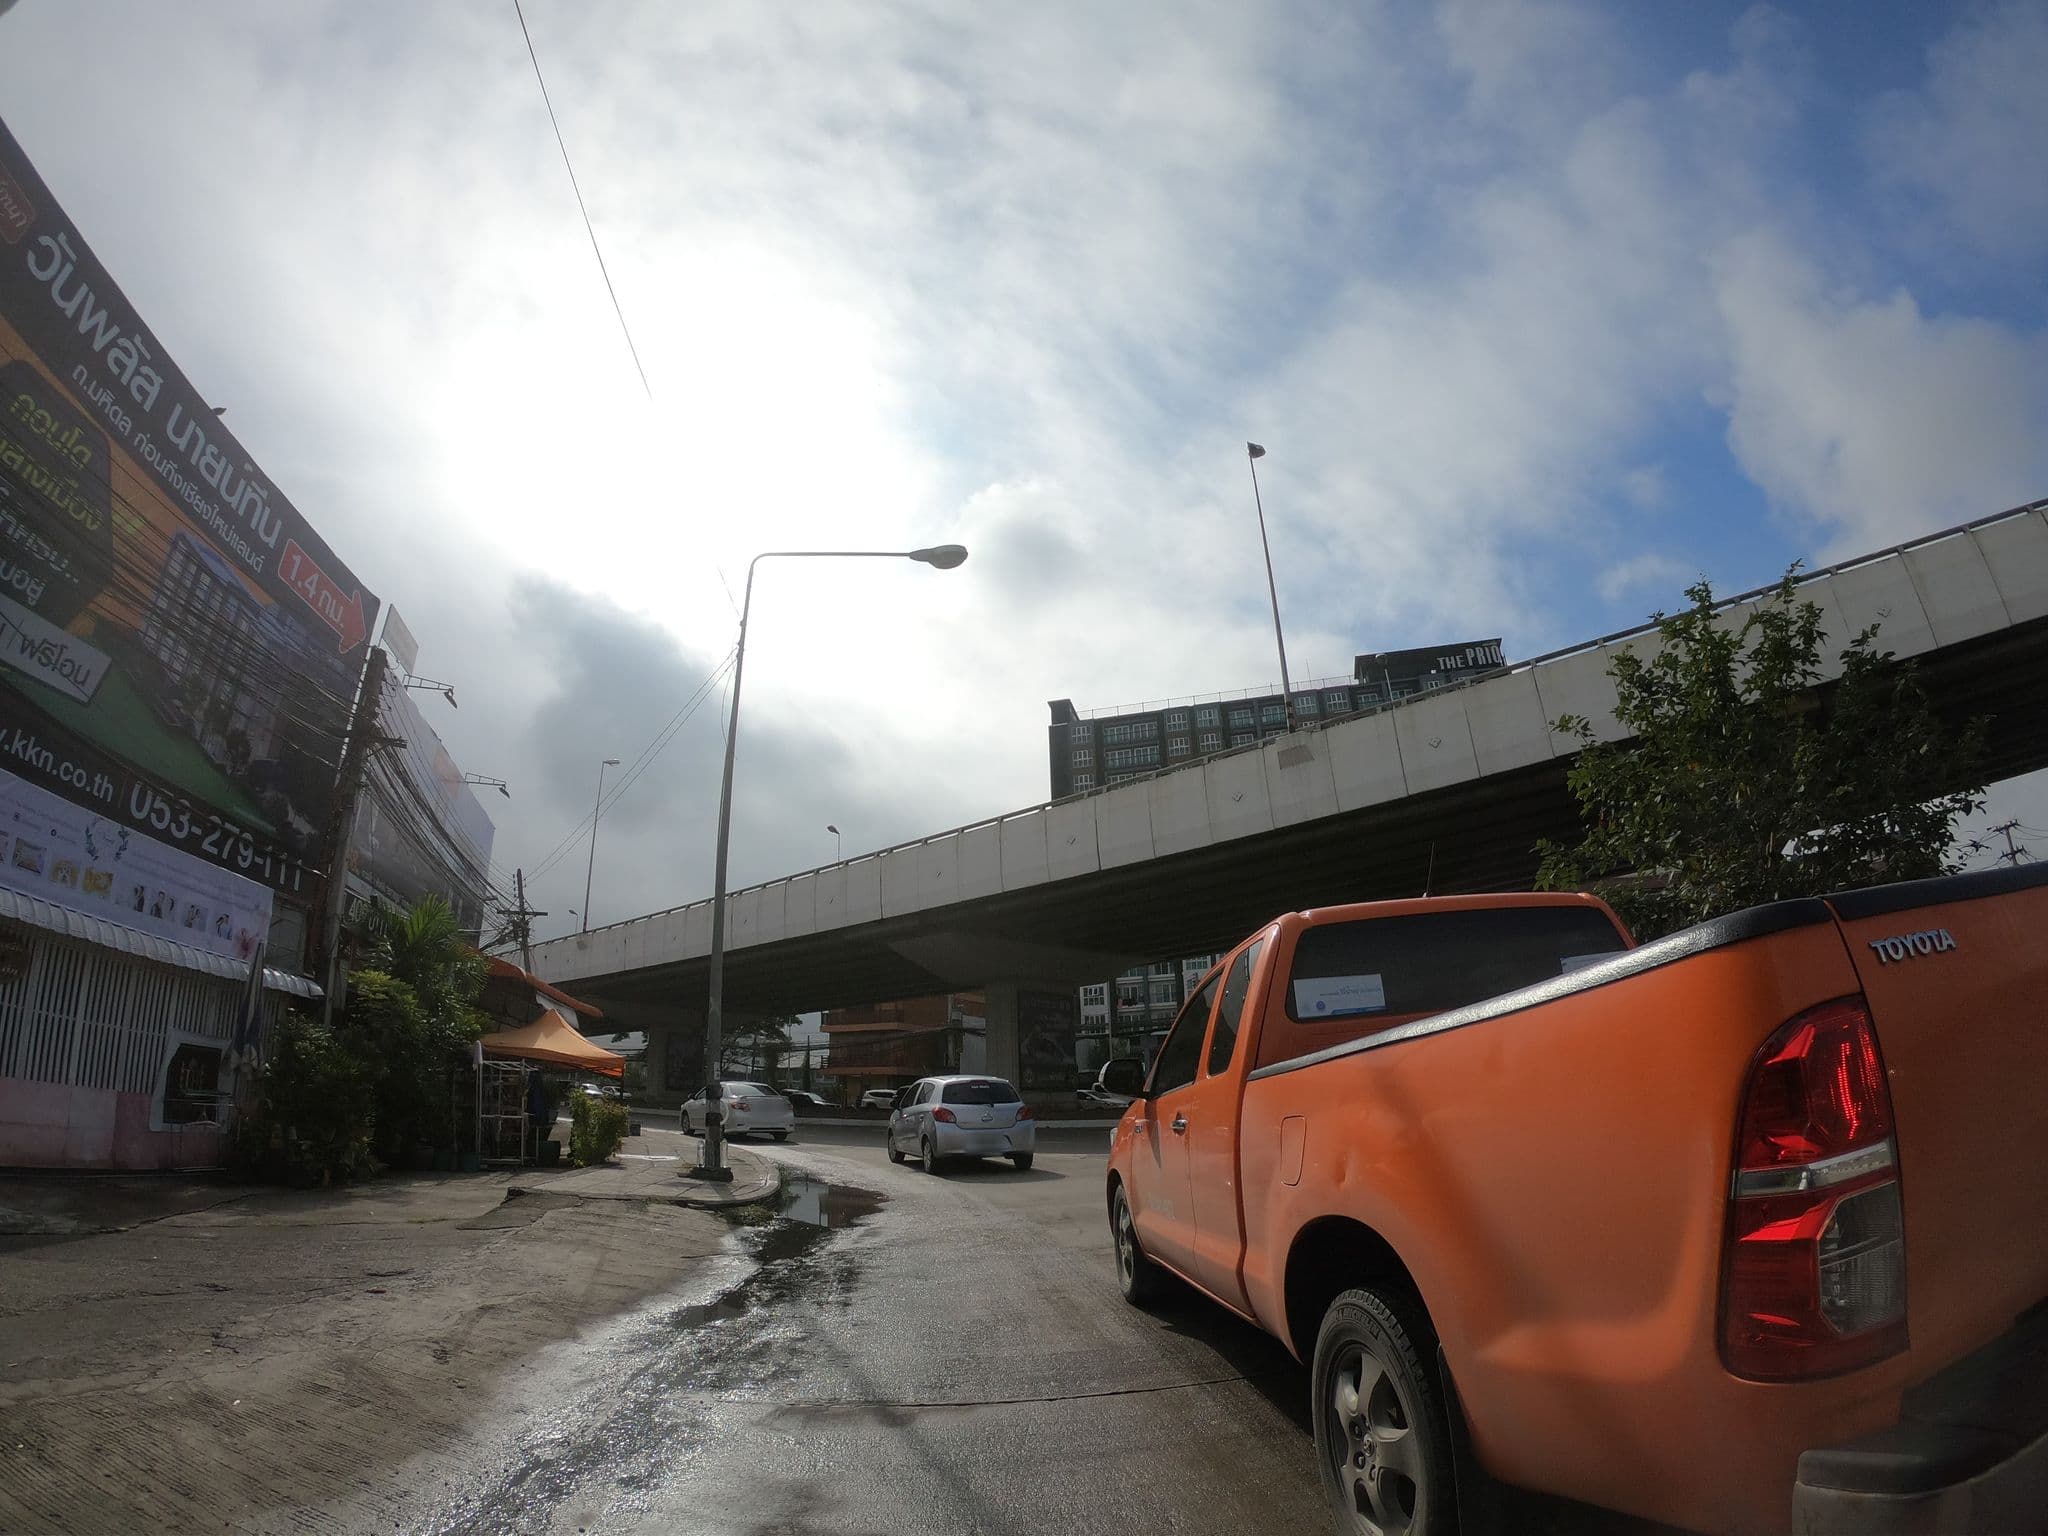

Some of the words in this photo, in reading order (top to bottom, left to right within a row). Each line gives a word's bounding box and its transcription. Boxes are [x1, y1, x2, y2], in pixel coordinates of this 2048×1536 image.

[27, 231, 164, 412] วันพลัส
[1436, 655, 1466, 670] THE
[1870, 928, 1957, 963] TOYOTA
